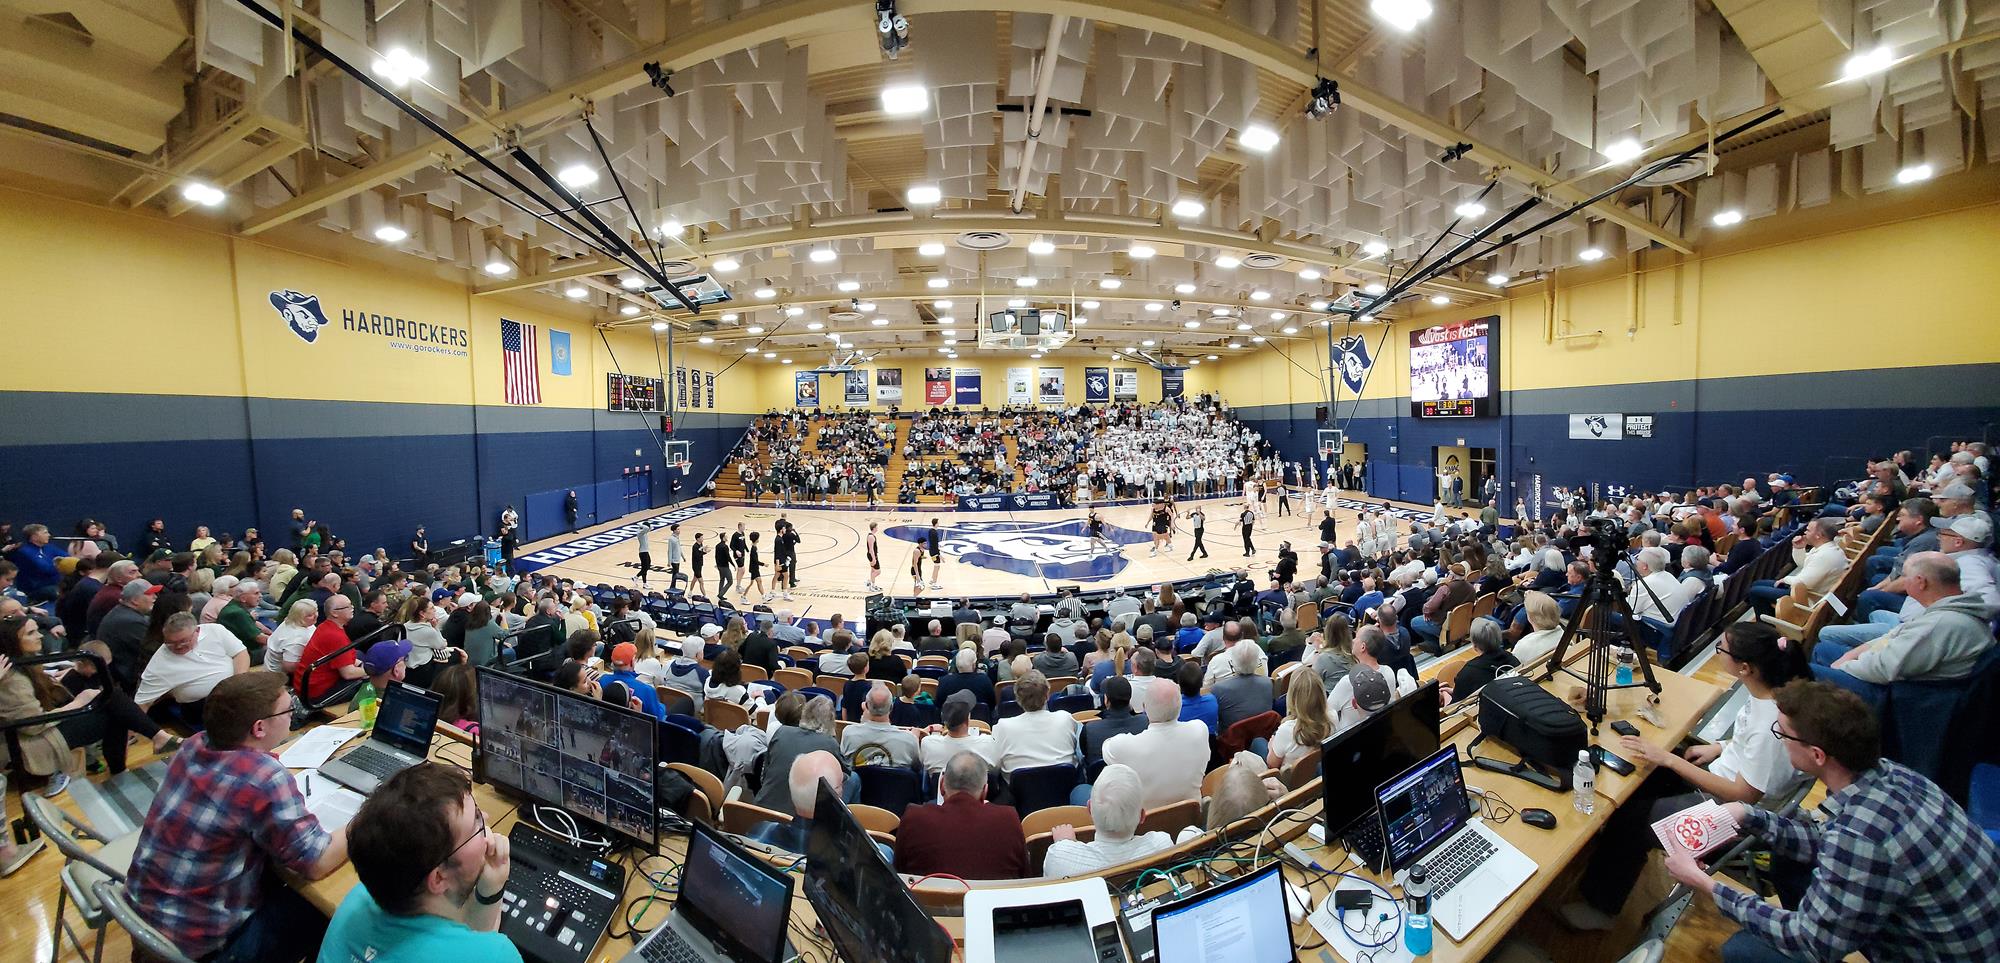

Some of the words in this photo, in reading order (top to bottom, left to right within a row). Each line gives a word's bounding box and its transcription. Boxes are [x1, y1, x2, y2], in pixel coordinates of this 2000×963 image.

[342, 308, 468, 348] HARDROCKERS
[1431, 328, 1449, 343] vast
[390, 341, 468, 357] www.gorockers.com
[1464, 406, 1472, 414] 33
[1684, 816, 1703, 837] POP
[1677, 824, 1703, 850] CORN
